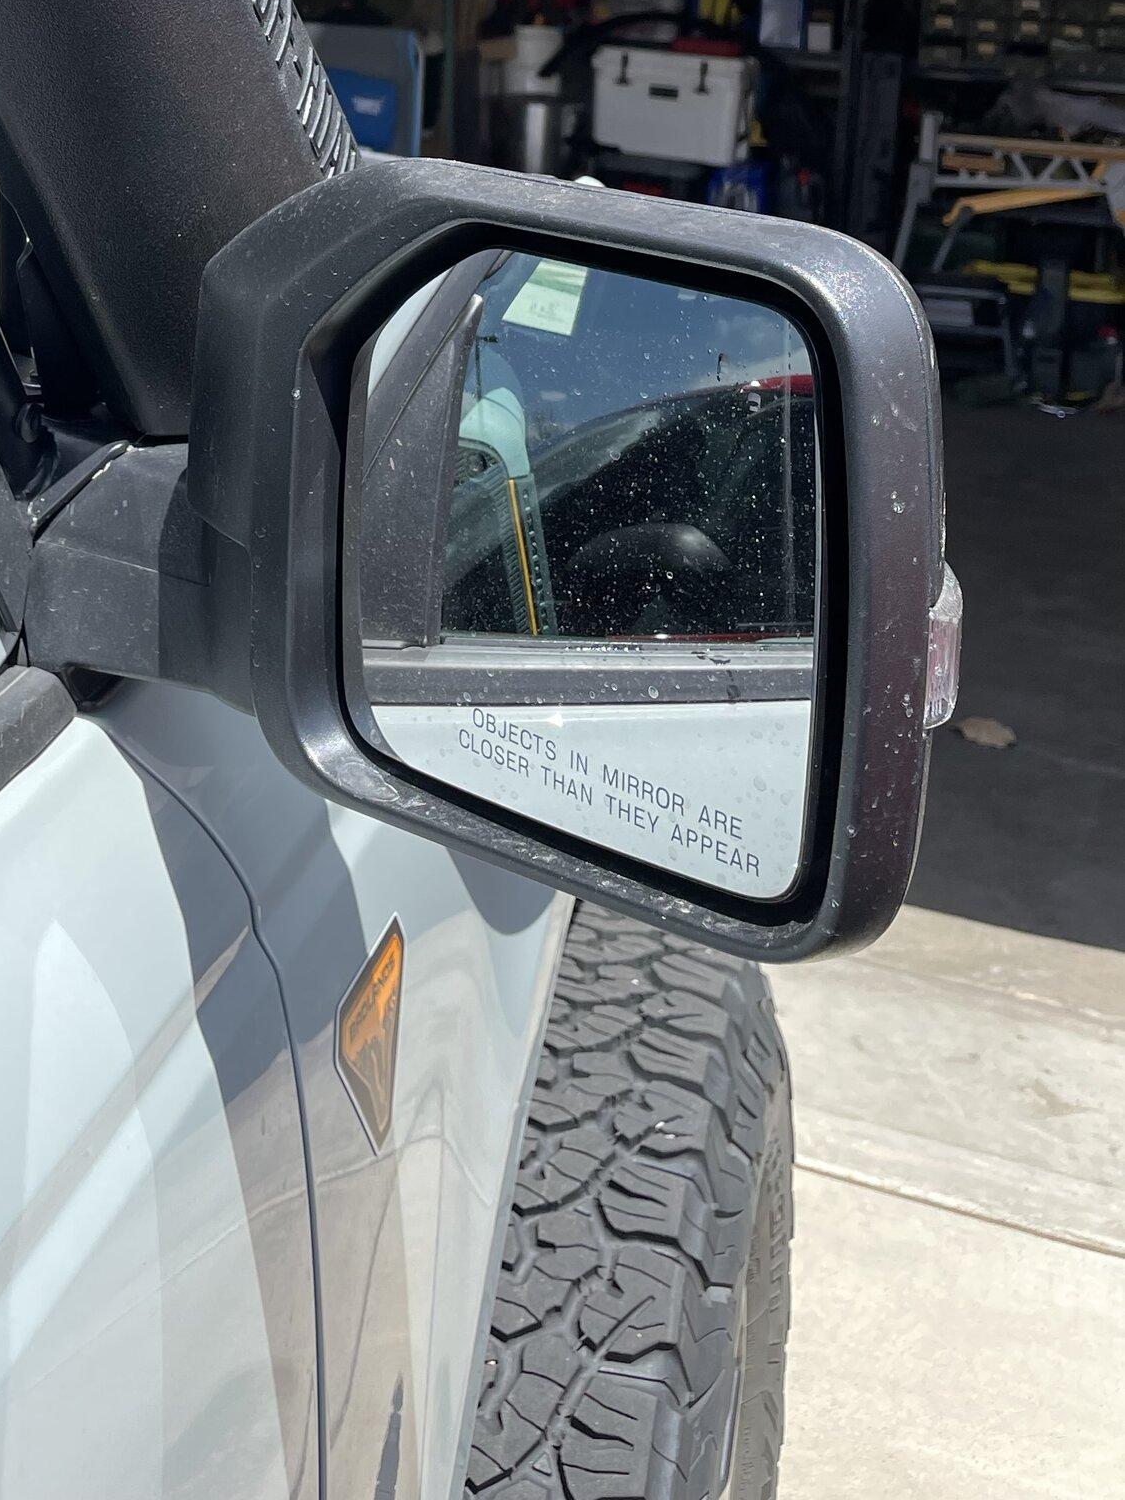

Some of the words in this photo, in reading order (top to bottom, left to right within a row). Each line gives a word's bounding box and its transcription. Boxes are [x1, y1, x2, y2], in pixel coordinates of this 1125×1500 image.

[458, 728, 530, 778] CLOSER
[540, 765, 593, 806] THAN
[605, 793, 660, 834] THEY
[670, 823, 761, 878] APPEAR
[472, 707, 557, 761] OBJECTS
[570, 749, 589, 775] IN
[602, 764, 685, 816] MIRROR
[697, 804, 743, 841] ARE
